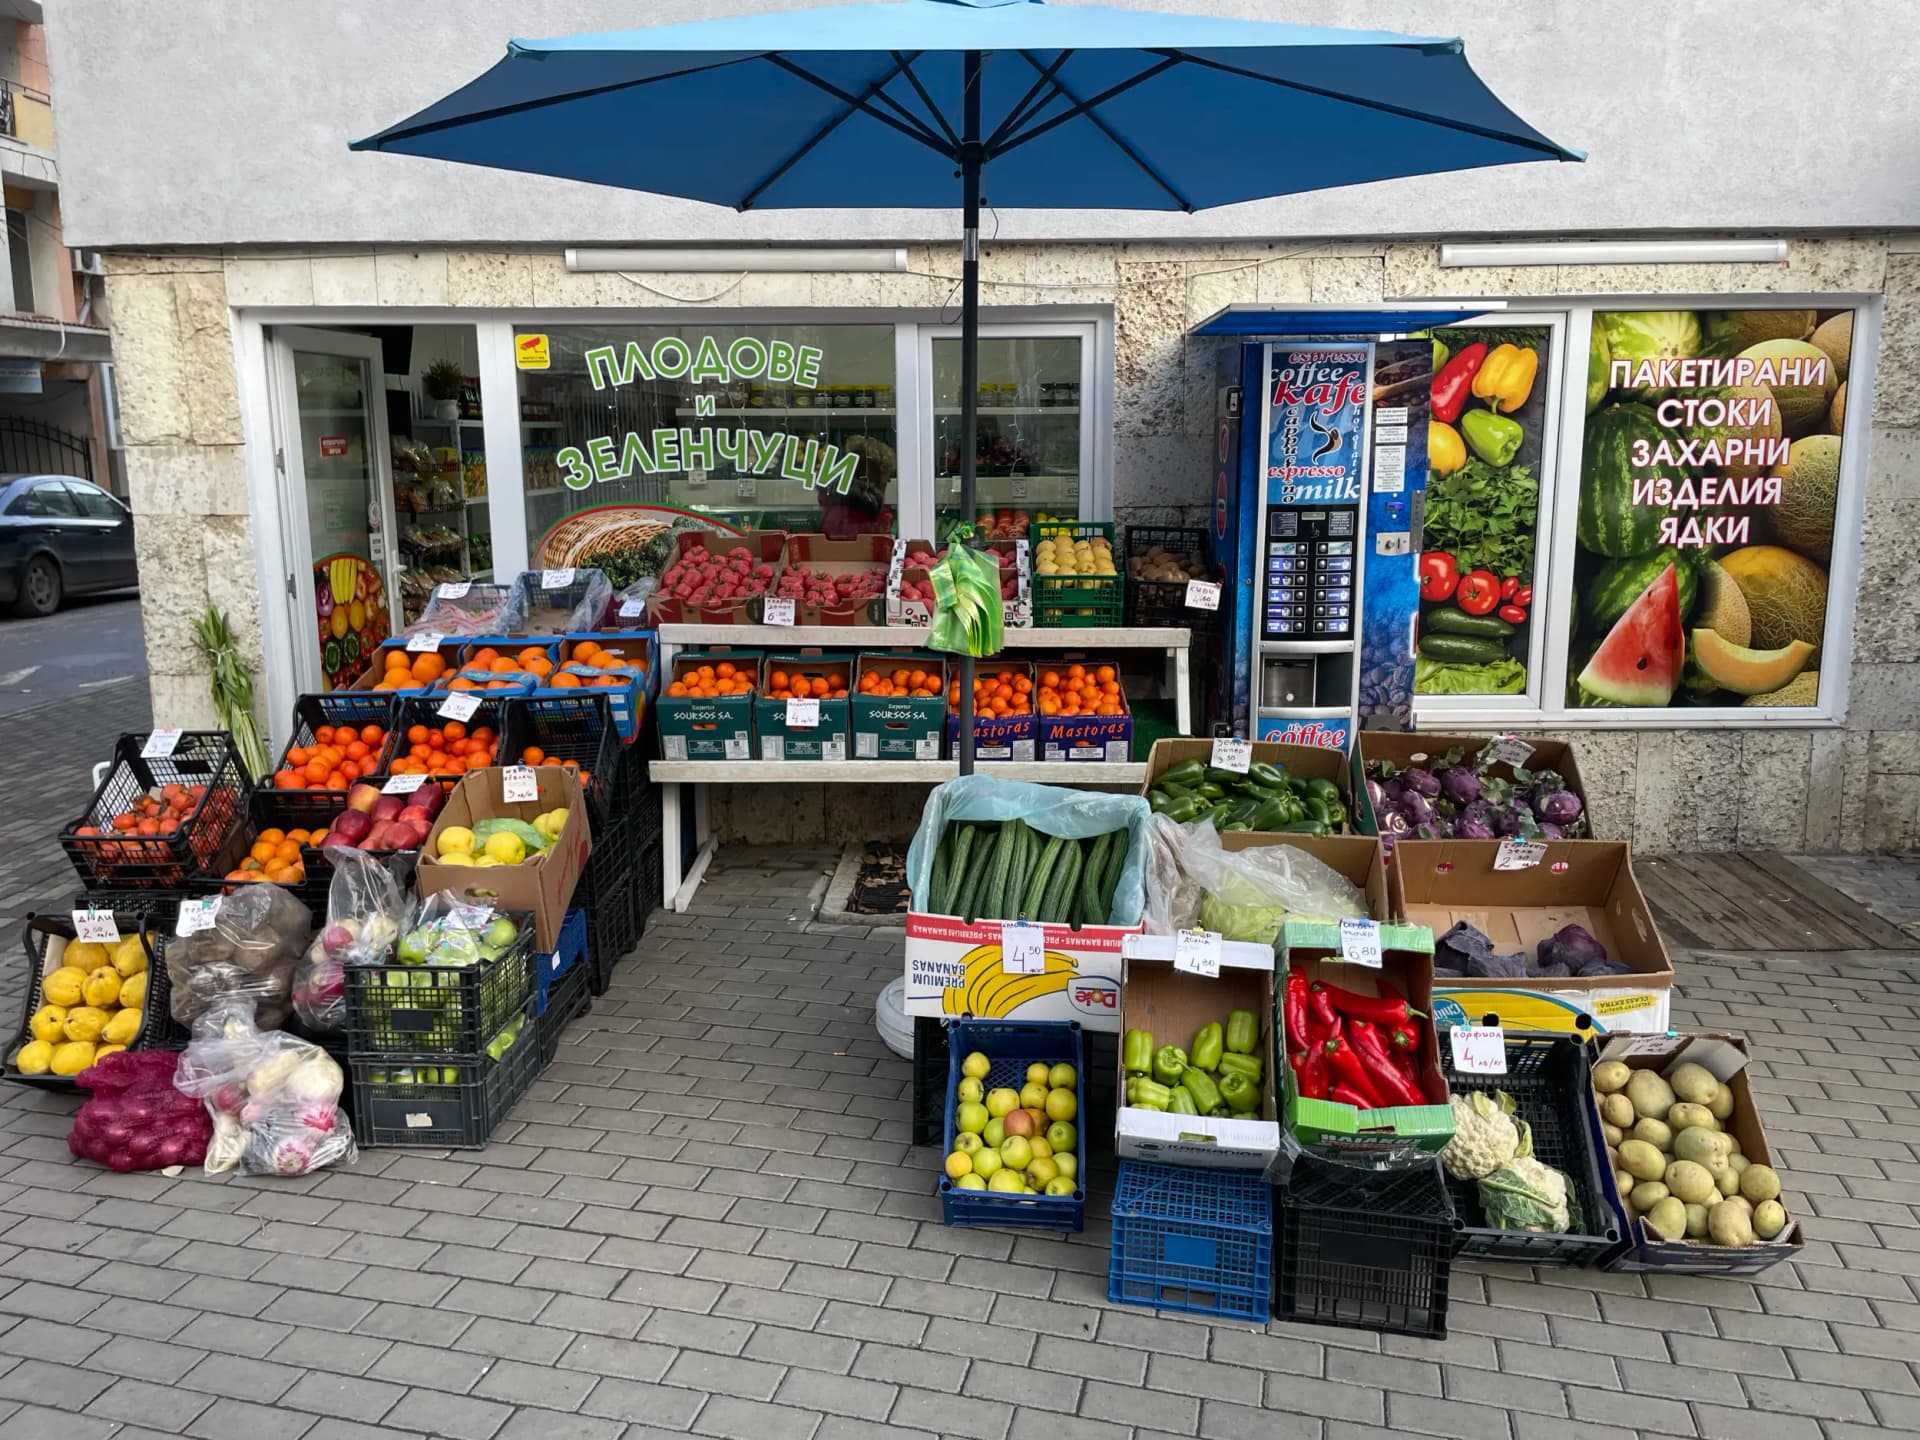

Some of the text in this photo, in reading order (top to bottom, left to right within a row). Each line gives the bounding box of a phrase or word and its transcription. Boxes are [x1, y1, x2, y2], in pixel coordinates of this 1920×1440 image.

[585, 336, 823, 389] ПЛОДОВЕ
[1289, 352, 1367, 364] espresso
[1271, 360, 1344, 389] coffee
[1609, 358, 1827, 388] ПАКЕТИРАНИ
[1273, 371, 1366, 416] kafe
[1657, 399, 1772, 427] СТОКИ
[556, 427, 860, 494] ЗЕЛЕНЧУЦИ
[1631, 438, 1790, 467] ЗАХАРНИ
[1267, 466, 1345, 481] espresso
[1294, 477, 1361, 500] milk
[1632, 477, 1782, 510] ИЗДЕЛИЯ
[1658, 516, 1749, 549] ЯДКИ
[673, 712, 717, 720] SOURSOS
[869, 710, 911, 719] SOURSOS
[1051, 722, 1125, 739] Mastoras
[1265, 722, 1345, 748] coffee
[1012, 945, 1041, 973] 4 50
[1190, 956, 1200, 971] 4
[1348, 946, 1377, 960] 6 80
[912, 960, 966, 976] BANANAS
[913, 973, 965, 989] PREMIUM
[1075, 990, 1116, 1008] Dole
[1463, 1047, 1474, 1068] 4
